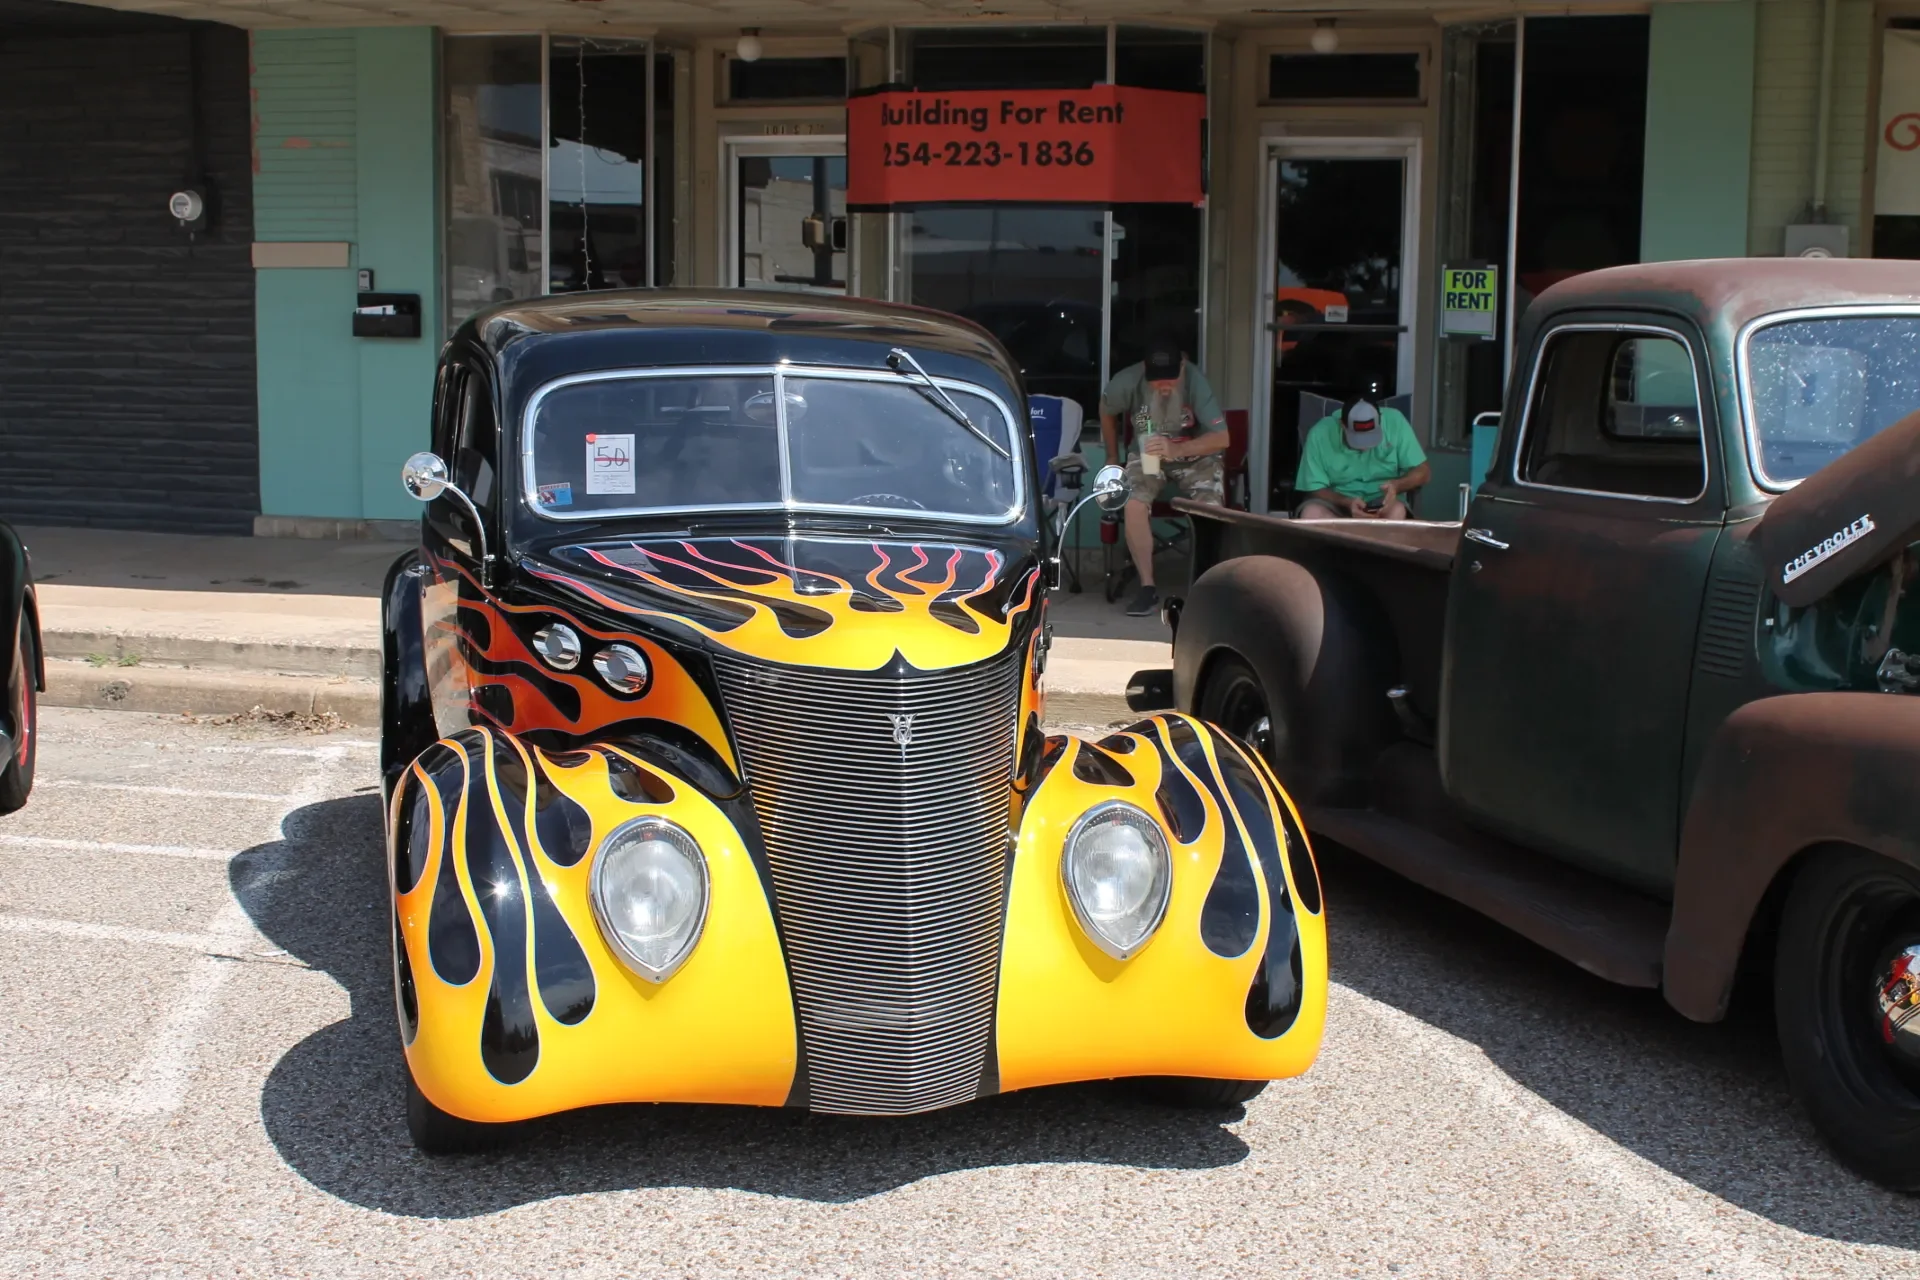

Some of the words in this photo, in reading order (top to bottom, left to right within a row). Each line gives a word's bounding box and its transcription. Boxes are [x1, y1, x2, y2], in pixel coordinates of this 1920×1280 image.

[1000, 100, 1047, 125] For
[1058, 100, 1124, 125] Rent
[884, 141, 1095, 167] 254-223-1836
[1452, 271, 1487, 289] FOR
[1446, 291, 1492, 310] RENT
[597, 446, 625, 467] 50
[1784, 513, 1871, 577] CHEVROLET
